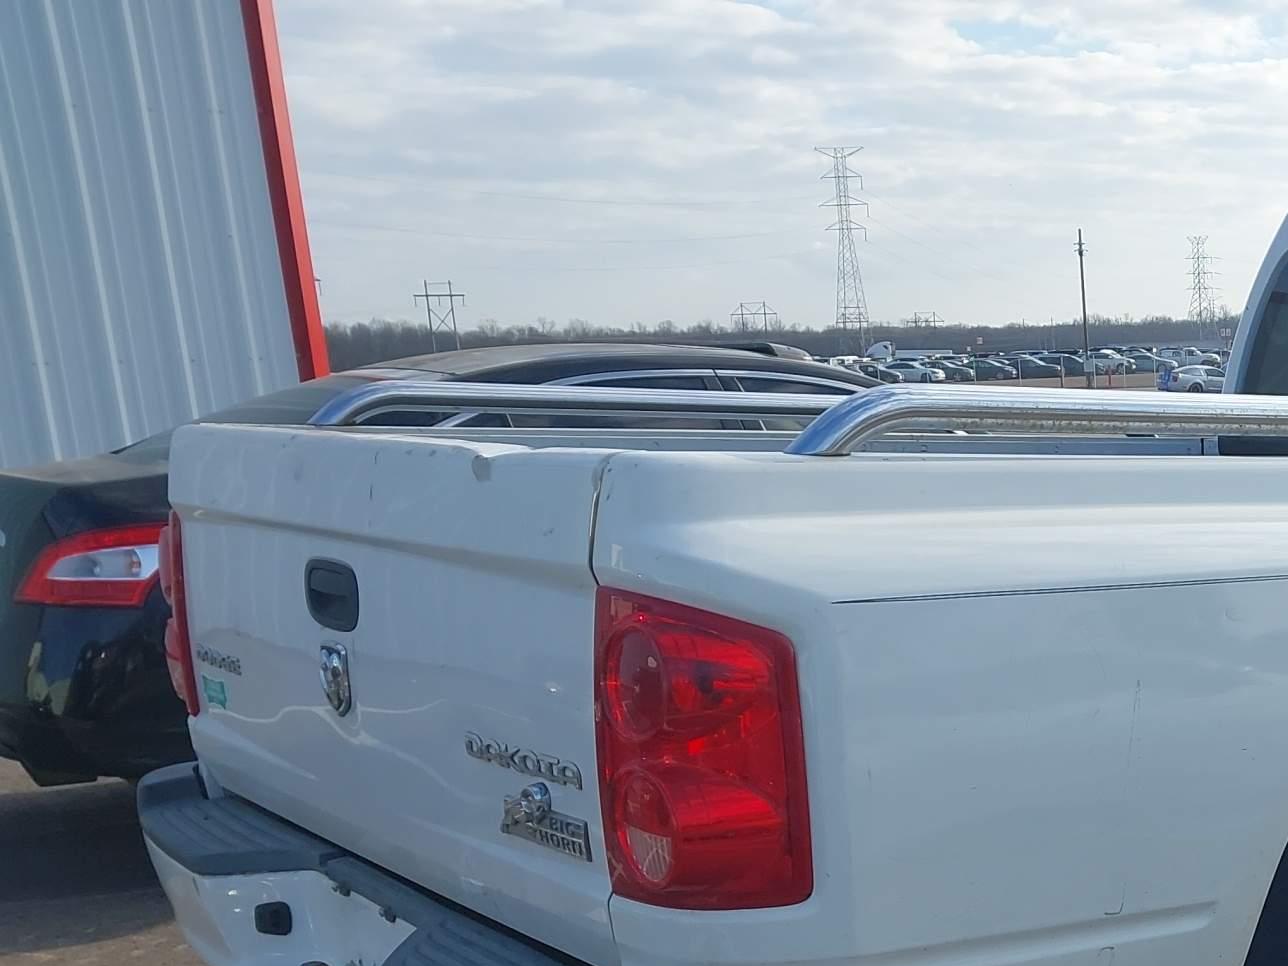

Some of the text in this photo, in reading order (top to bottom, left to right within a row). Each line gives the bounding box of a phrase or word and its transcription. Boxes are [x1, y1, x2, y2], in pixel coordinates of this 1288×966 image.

[464, 730, 583, 791] DAKOTA
[548, 816, 584, 838] BIG
[538, 829, 585, 857] HORN
